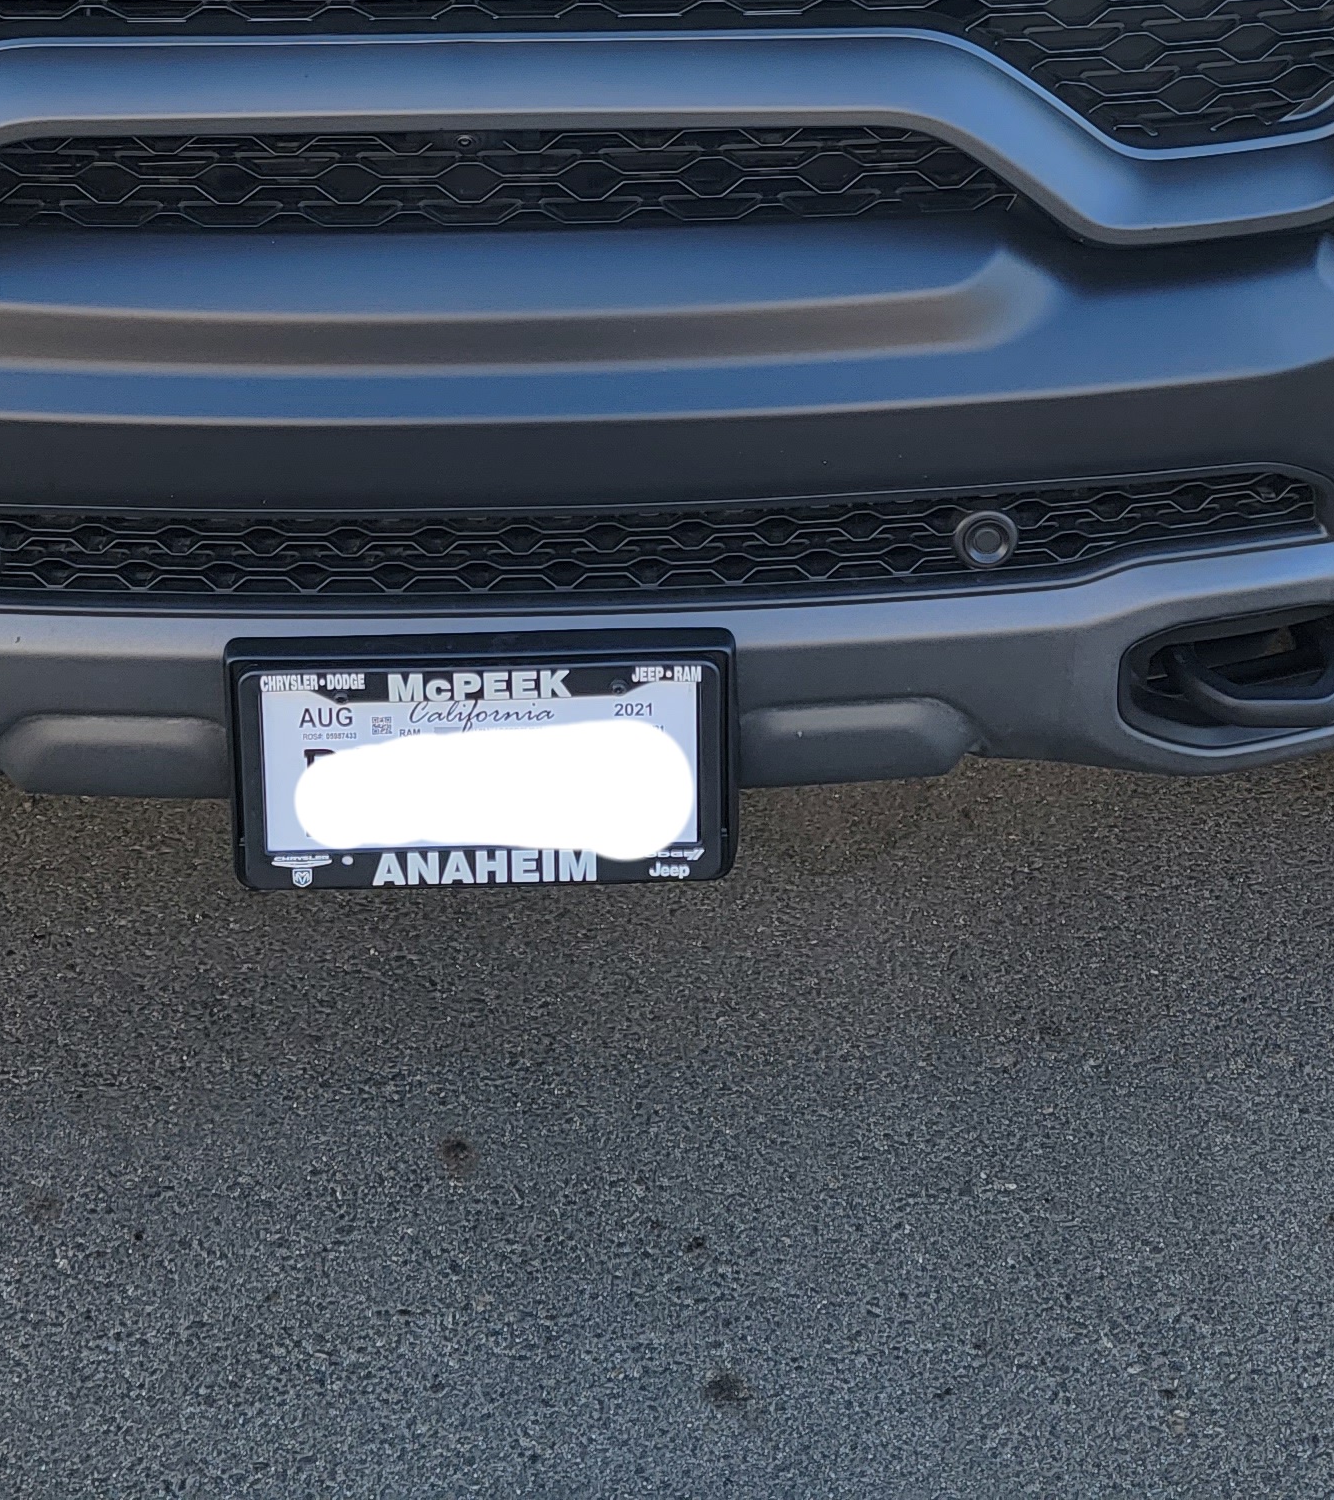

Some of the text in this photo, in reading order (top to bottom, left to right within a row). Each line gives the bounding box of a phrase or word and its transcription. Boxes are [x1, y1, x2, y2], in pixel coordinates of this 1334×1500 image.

[387, 669, 571, 703] McPEEK
[299, 707, 353, 729] AUG
[409, 698, 555, 733] California
[614, 703, 653, 717] 2021
[372, 849, 598, 887] ANAHEIM
[649, 861, 690, 879] Jeep
